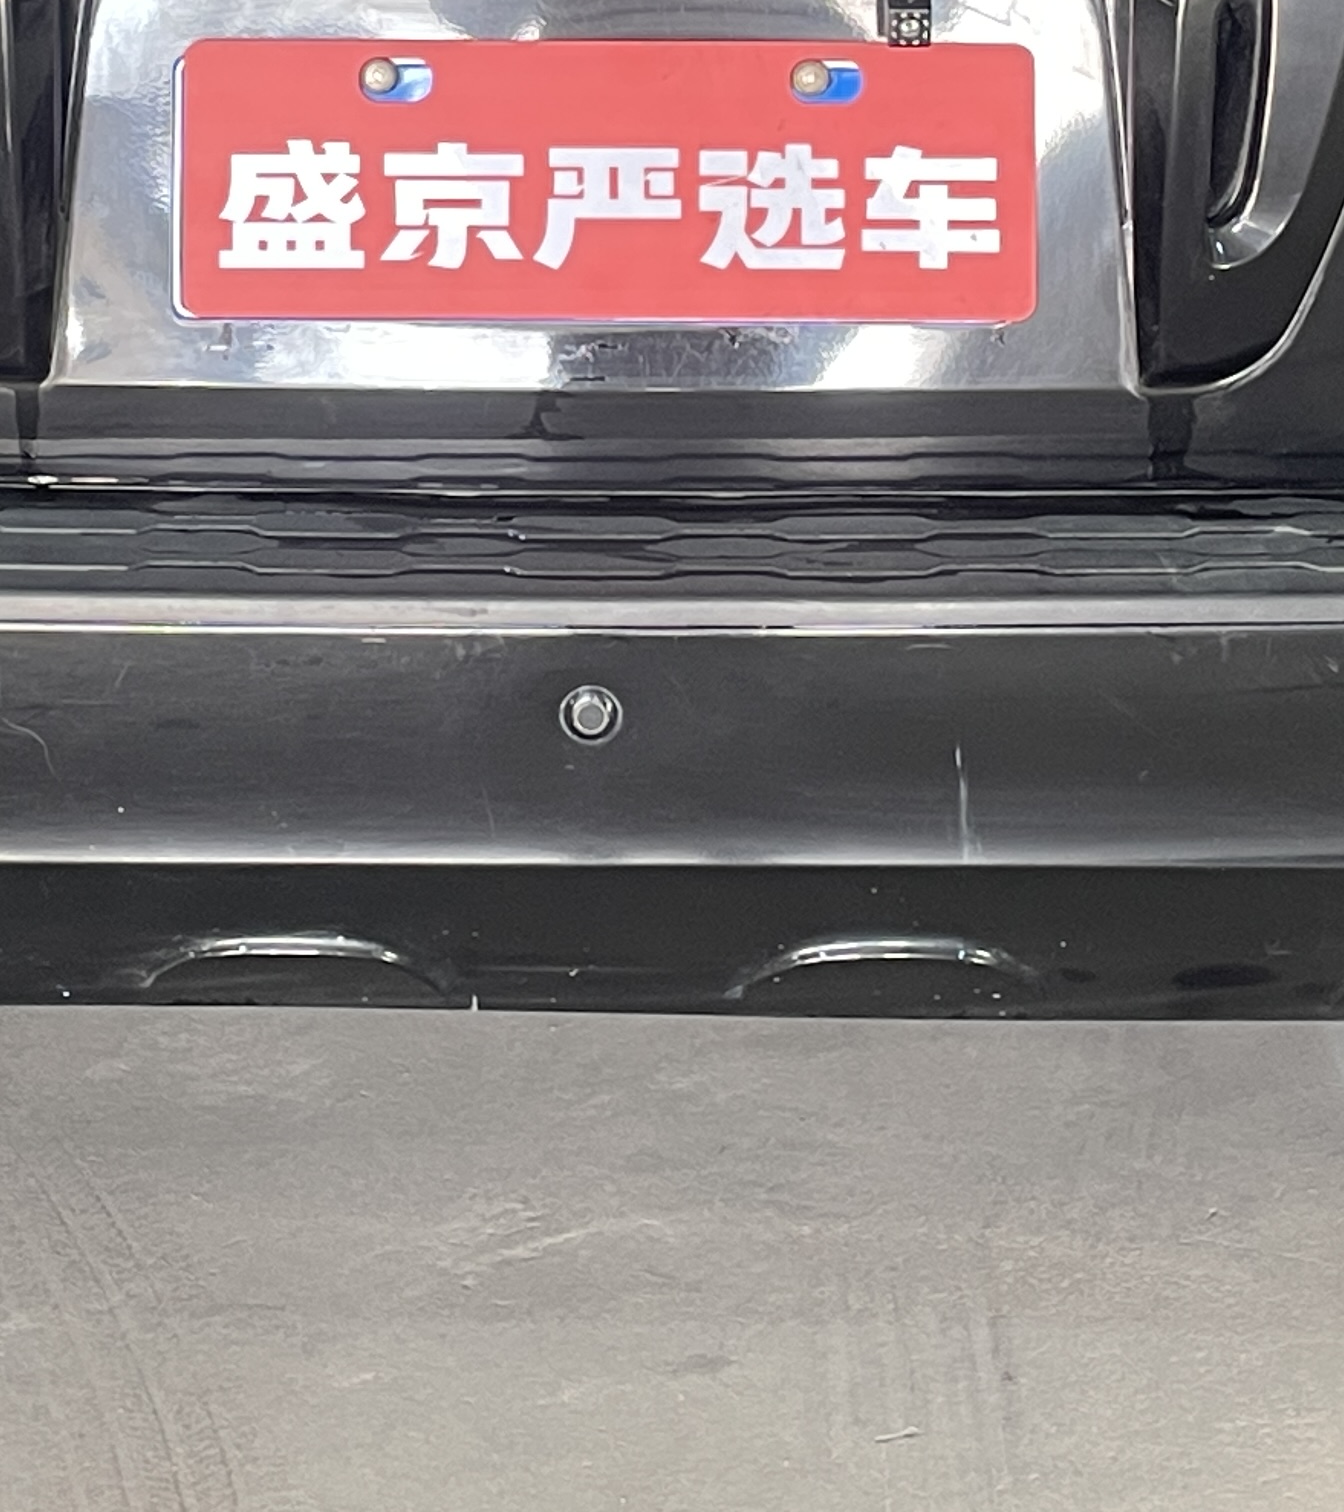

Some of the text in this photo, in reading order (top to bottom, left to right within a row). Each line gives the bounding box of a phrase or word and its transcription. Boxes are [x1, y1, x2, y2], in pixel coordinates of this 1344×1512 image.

[217, 138, 1002, 271] 盛京严选车
